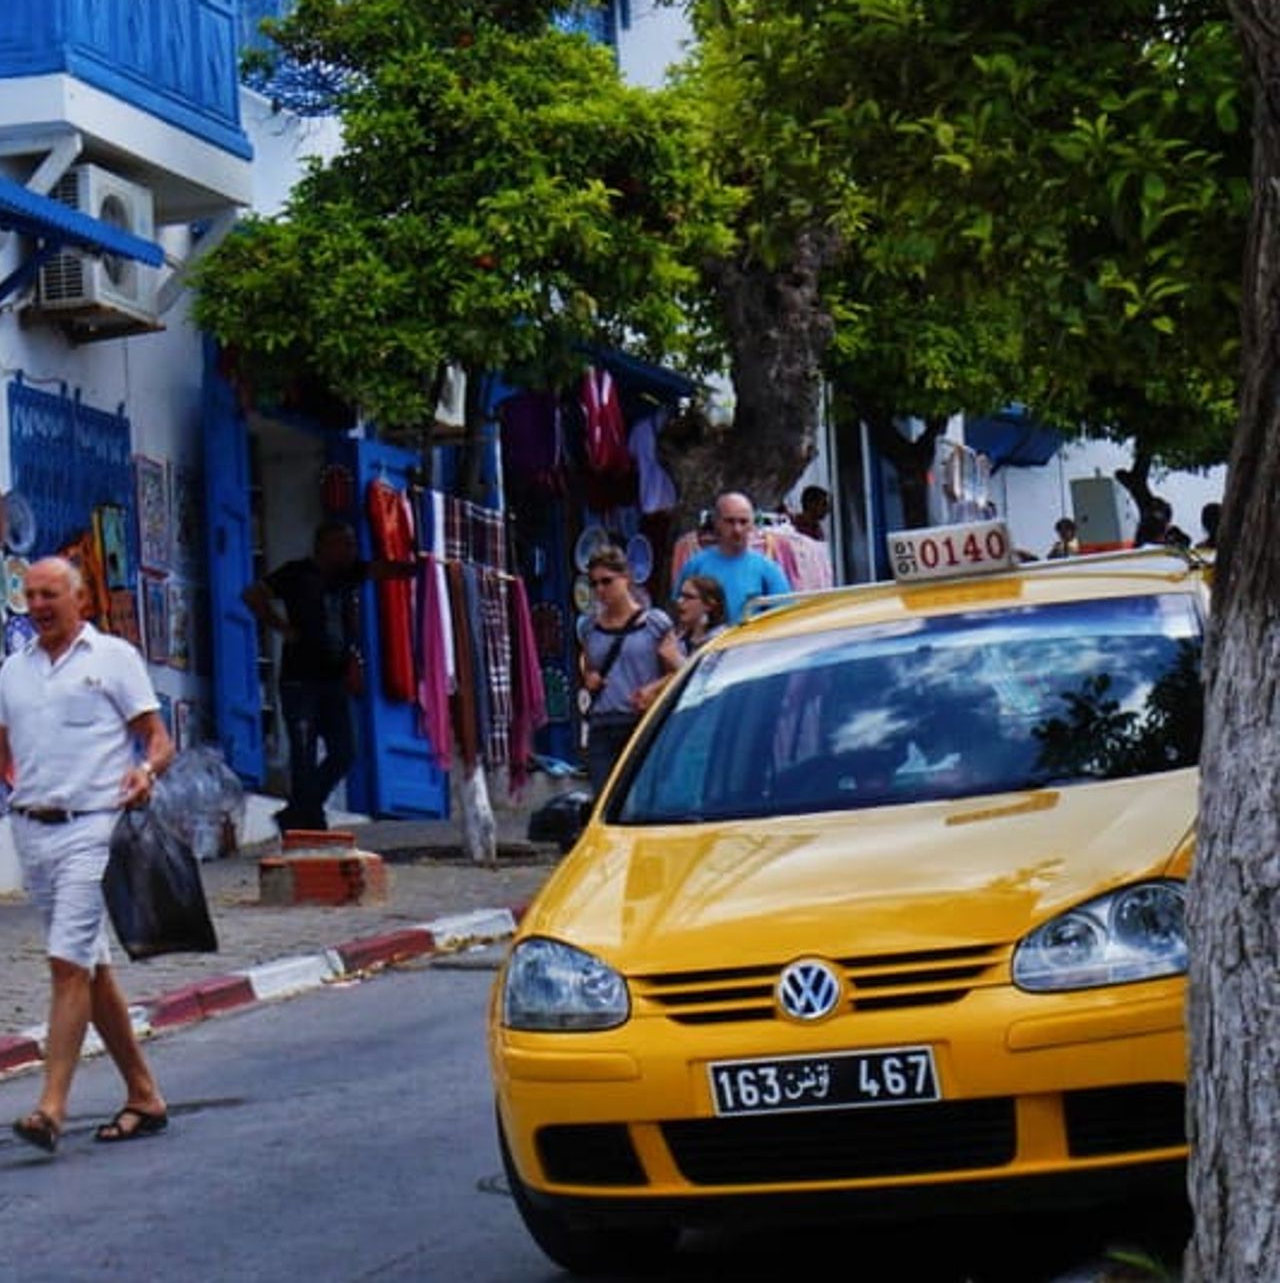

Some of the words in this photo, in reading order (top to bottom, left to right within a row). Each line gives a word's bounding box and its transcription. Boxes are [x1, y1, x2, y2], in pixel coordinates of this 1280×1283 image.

[895, 541, 914, 555] 01
[920, 529, 1005, 569] 0140
[898, 560, 918, 574] 01
[718, 1066, 781, 1108] 163
[858, 1055, 928, 1097] 467
